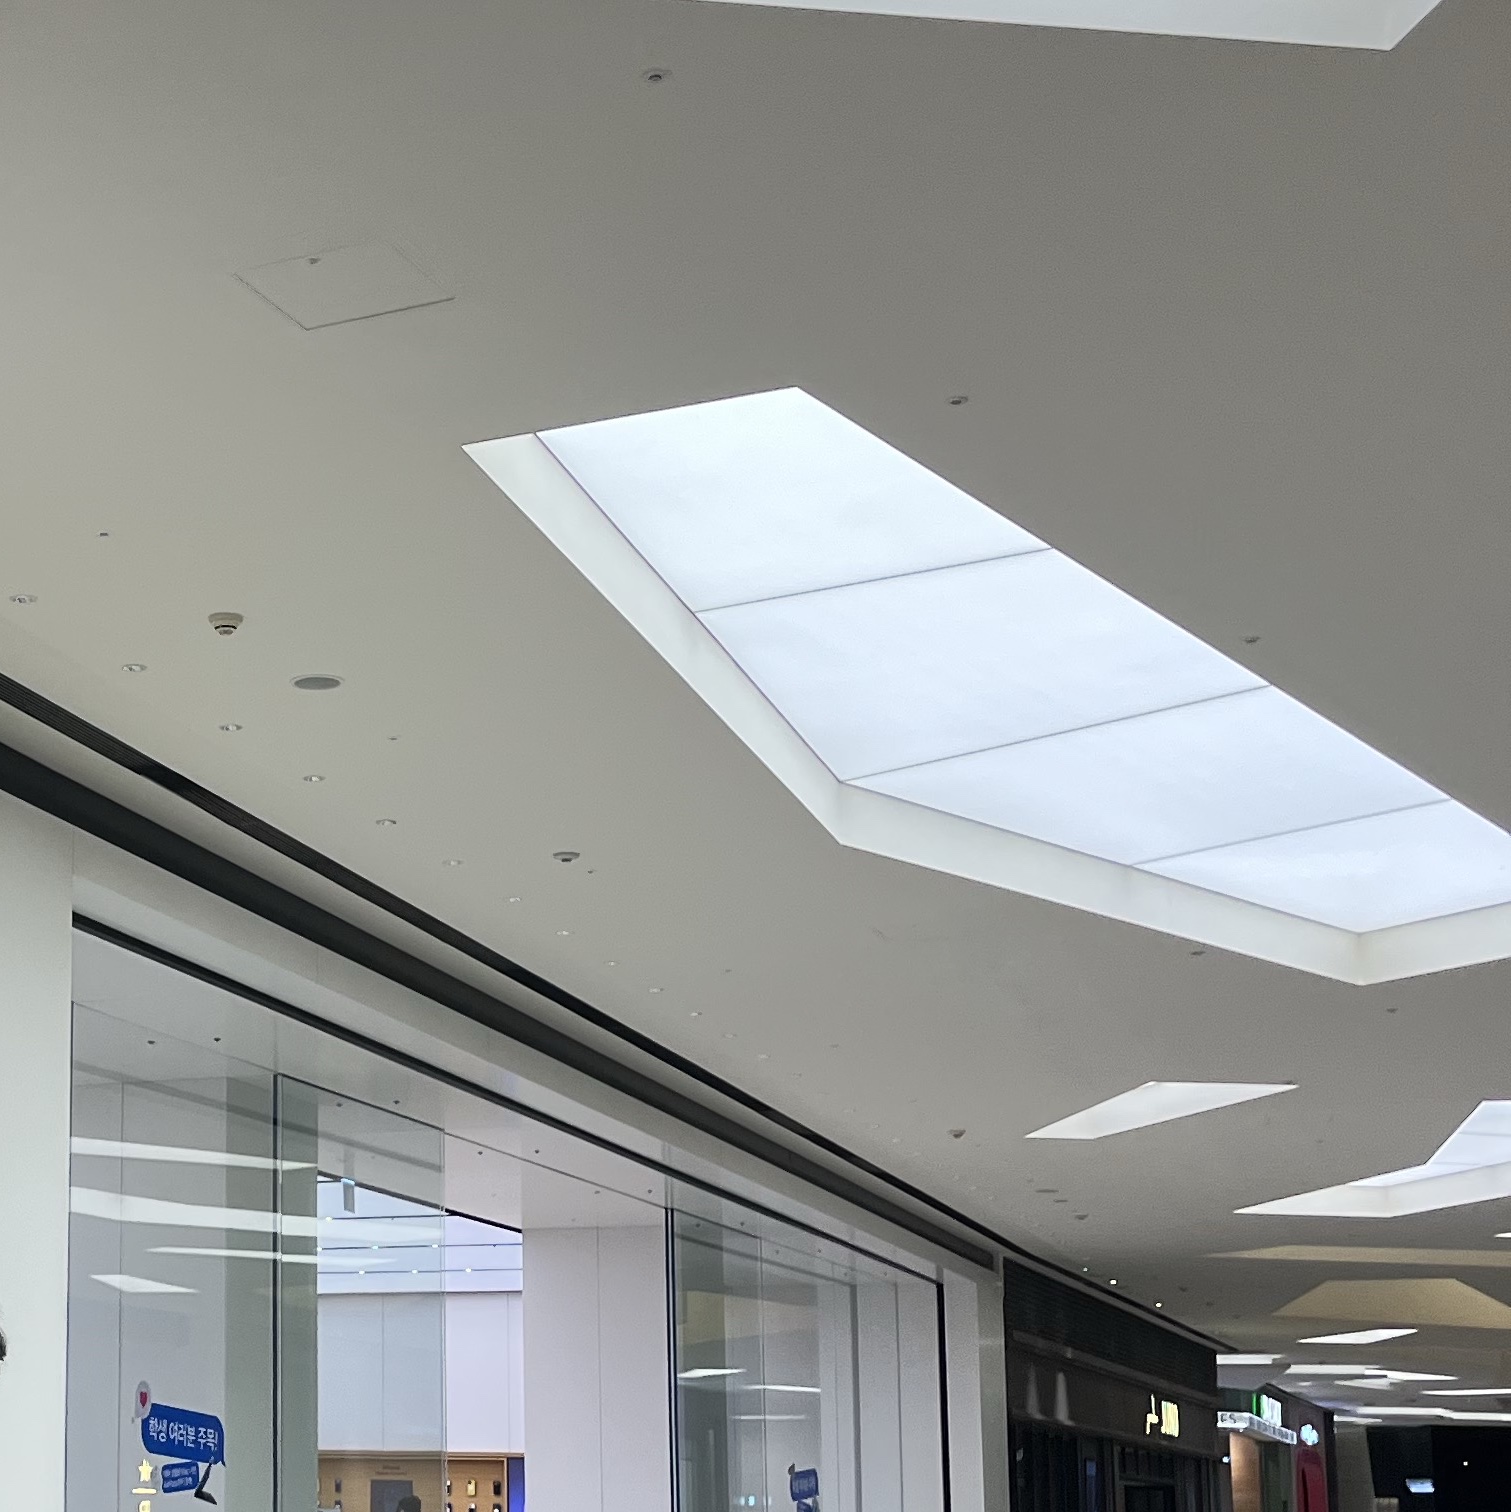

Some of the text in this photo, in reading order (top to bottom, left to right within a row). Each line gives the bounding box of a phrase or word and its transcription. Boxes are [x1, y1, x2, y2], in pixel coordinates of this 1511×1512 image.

[148, 1416, 218, 1451] 학생 여러분 주목!
